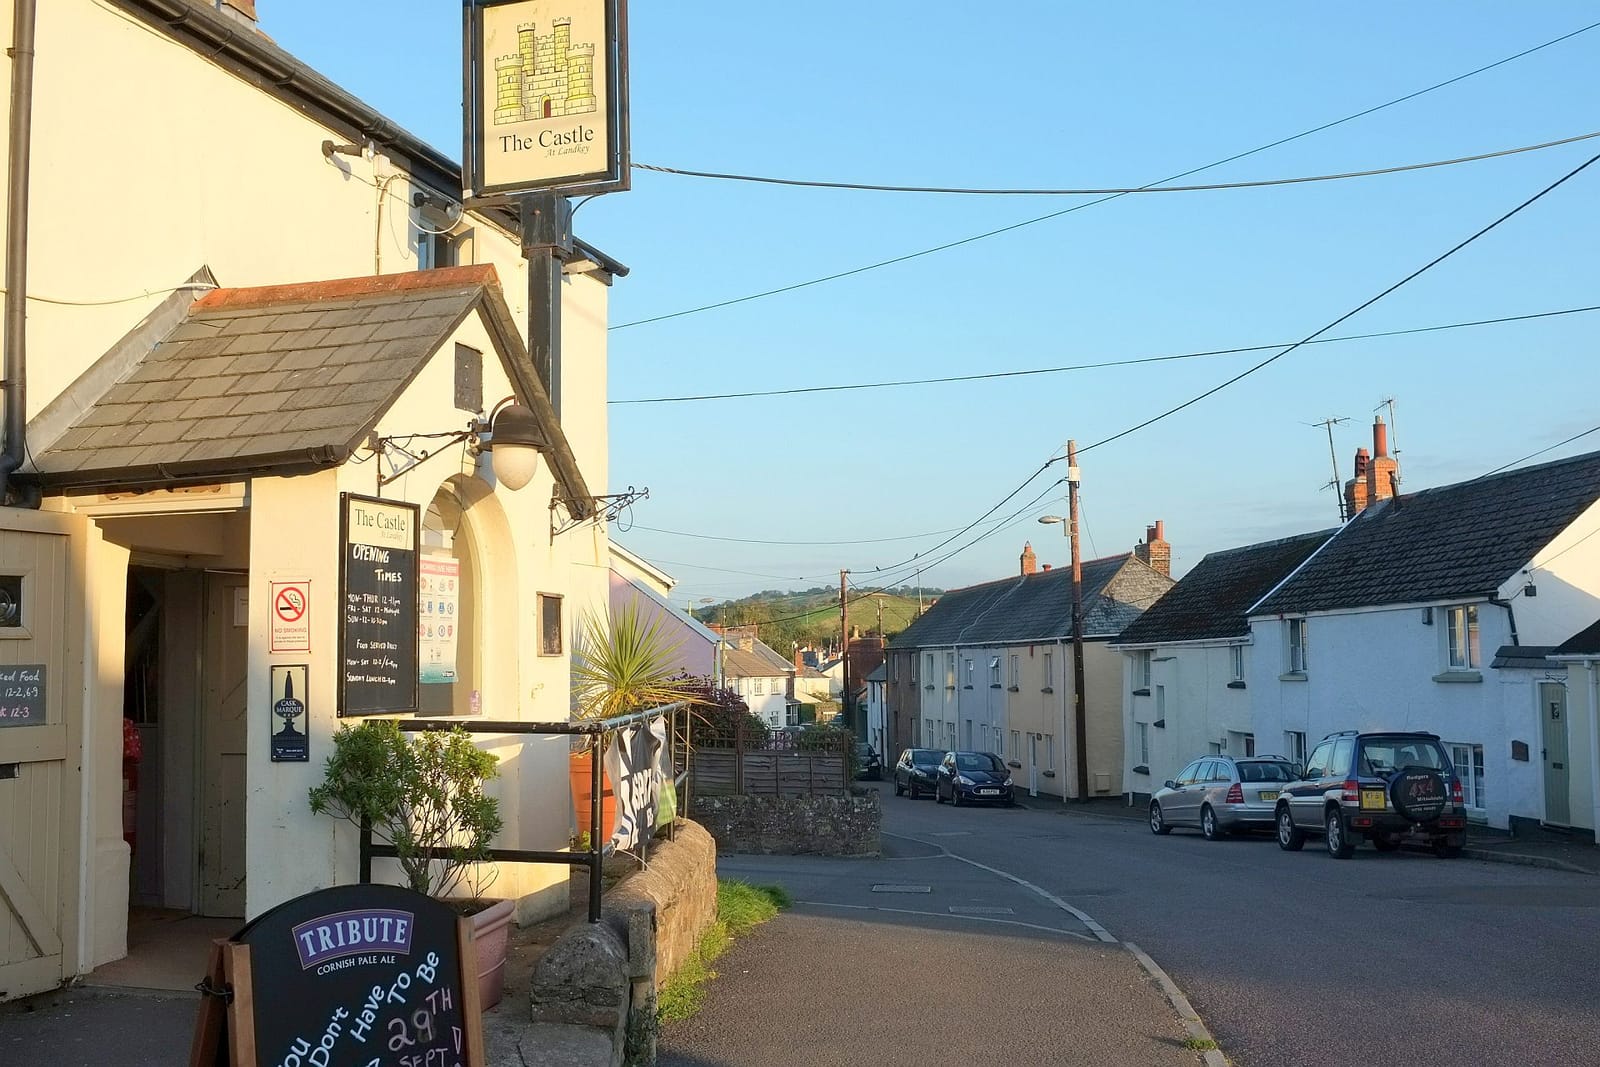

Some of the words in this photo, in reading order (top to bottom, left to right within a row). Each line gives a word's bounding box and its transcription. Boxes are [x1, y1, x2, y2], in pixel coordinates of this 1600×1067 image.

[499, 134, 533, 152] The
[539, 125, 594, 147] Castle
[545, 149, 555, 158] At
[558, 144, 590, 156] Landkey
[355, 508, 374, 527] The
[377, 512, 406, 531] Castle
[353, 544, 390, 563] OPENING
[19, 669, 40, 681] Food
[11, 706, 30, 717] 12-3
[300, 917, 408, 957] TRIBUTE
[317, 957, 355, 975] CORNISH
[358, 955, 378, 965] PALE
[380, 955, 396, 964] ALE
[278, 1037, 311, 1067] ou
[350, 985, 385, 1043] Have
[416, 951, 440, 984] Be
